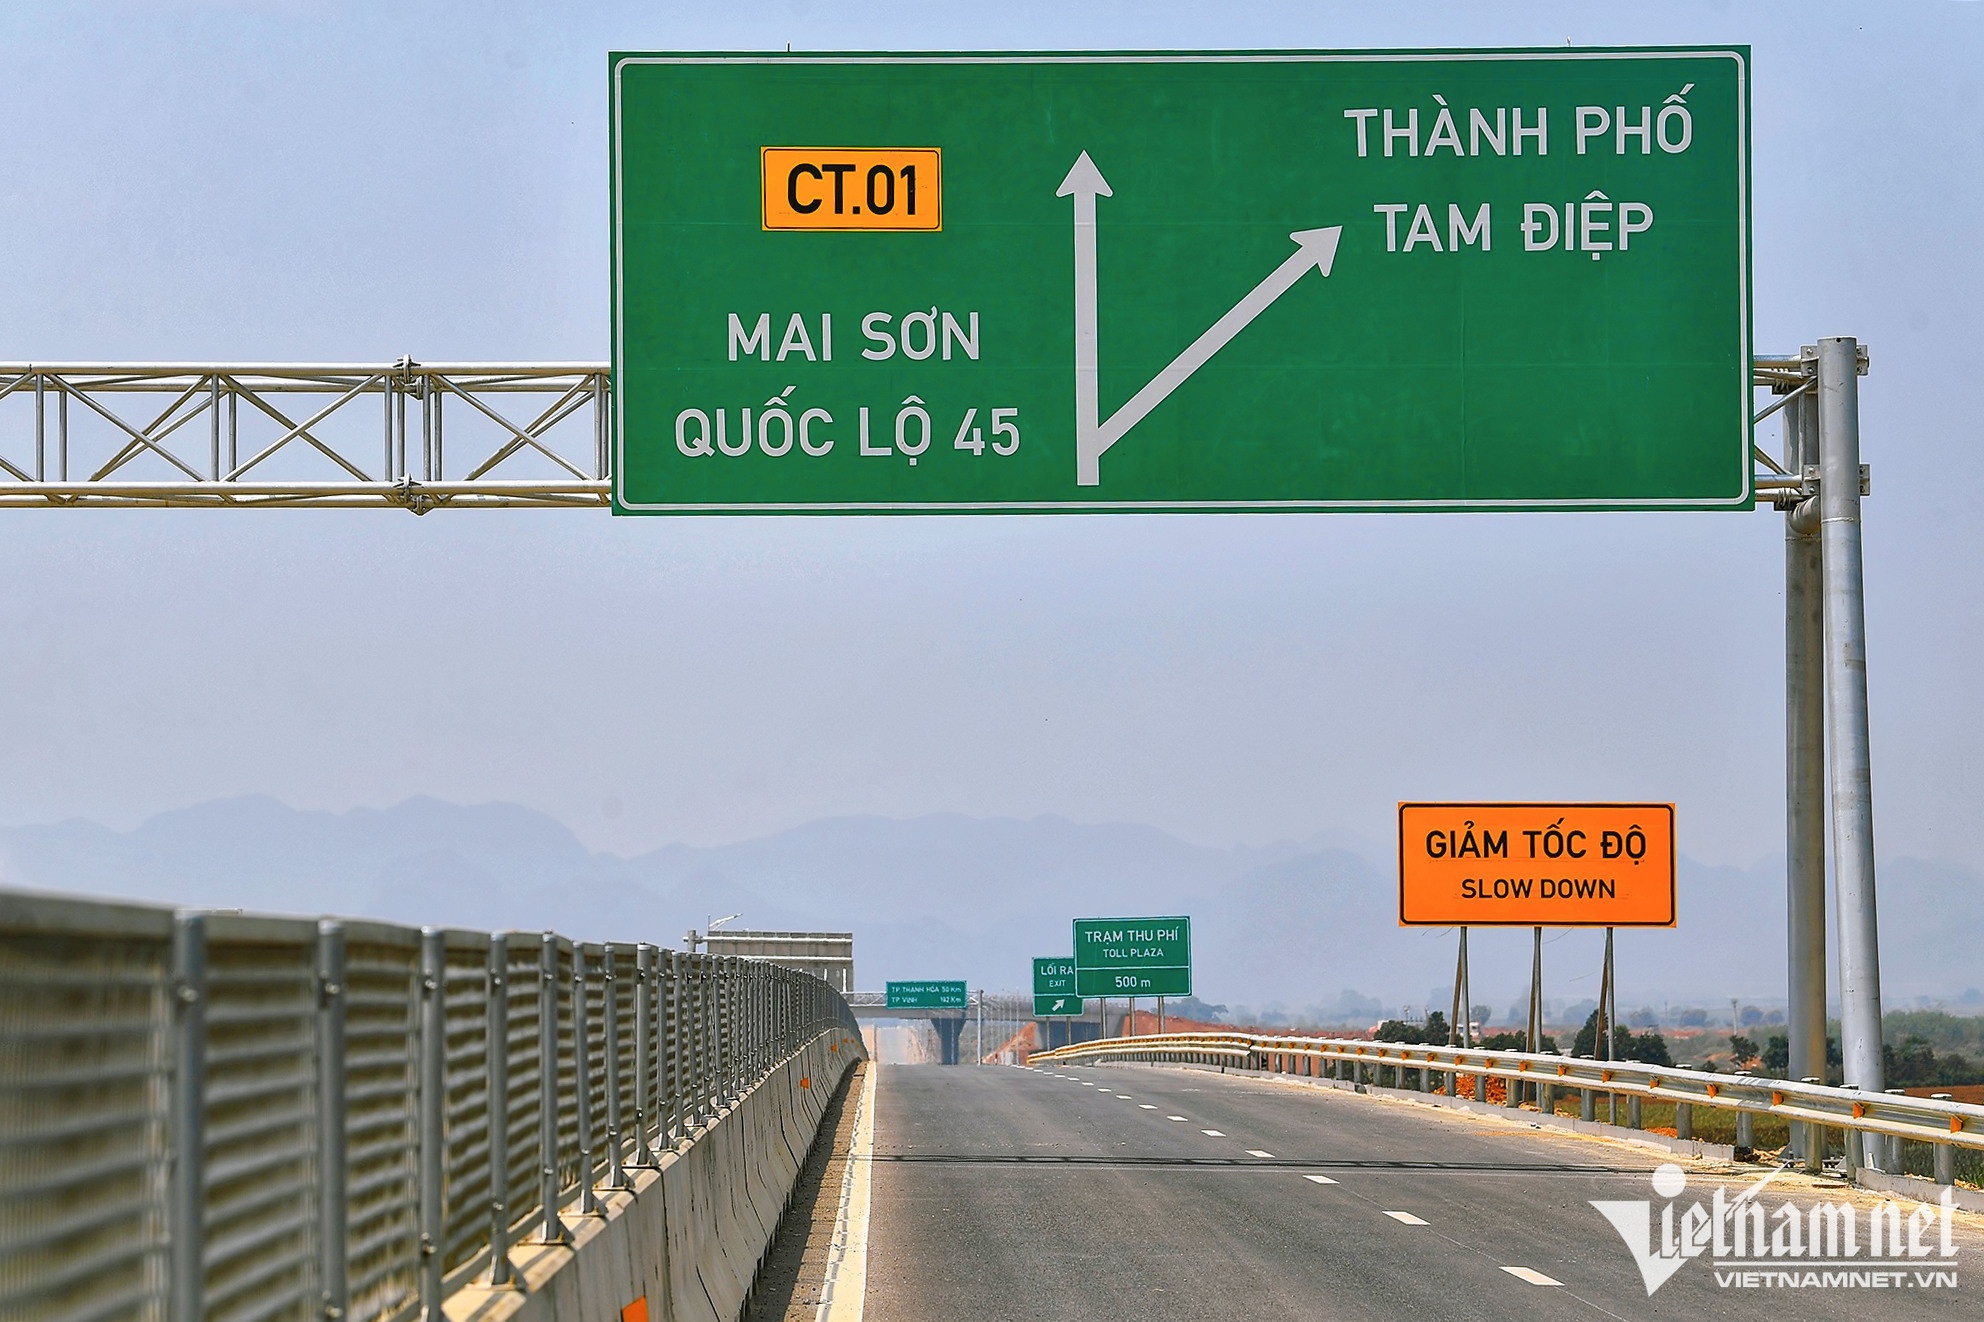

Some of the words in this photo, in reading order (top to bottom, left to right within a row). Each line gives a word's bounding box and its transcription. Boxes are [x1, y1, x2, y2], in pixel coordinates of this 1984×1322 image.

[1343, 94, 1548, 157] THÀNH
[1576, 83, 1695, 155] PHỐ
[787, 163, 917, 216] CT.01
[1373, 202, 1492, 252] TAM
[1520, 190, 1654, 260] ĐIỆP
[728, 313, 832, 362] MAI
[861, 306, 979, 361] SƠN
[675, 386, 833, 457] QUỐC
[859, 395, 931, 466] LỘ
[954, 408, 1020, 457] 45
[1426, 820, 1508, 858] GIẢM
[1522, 818, 1586, 858] TỐC
[1600, 824, 1646, 865] ĐỘ
[1462, 878, 1532, 898] SLOW
[1540, 879, 1615, 898] DOWN
[1085, 931, 1123, 945] TRẠM
[1127, 930, 1153, 941] THU
[1157, 926, 1179, 941] PHÍ
[1103, 949, 1128, 958] TOLL
[1131, 948, 1163, 957] PLAZA
[1041, 963, 1056, 975] LỐI
[1060, 965, 1073, 975] RA
[1115, 976, 1137, 987] 500
[1141, 979, 1150, 987] m
